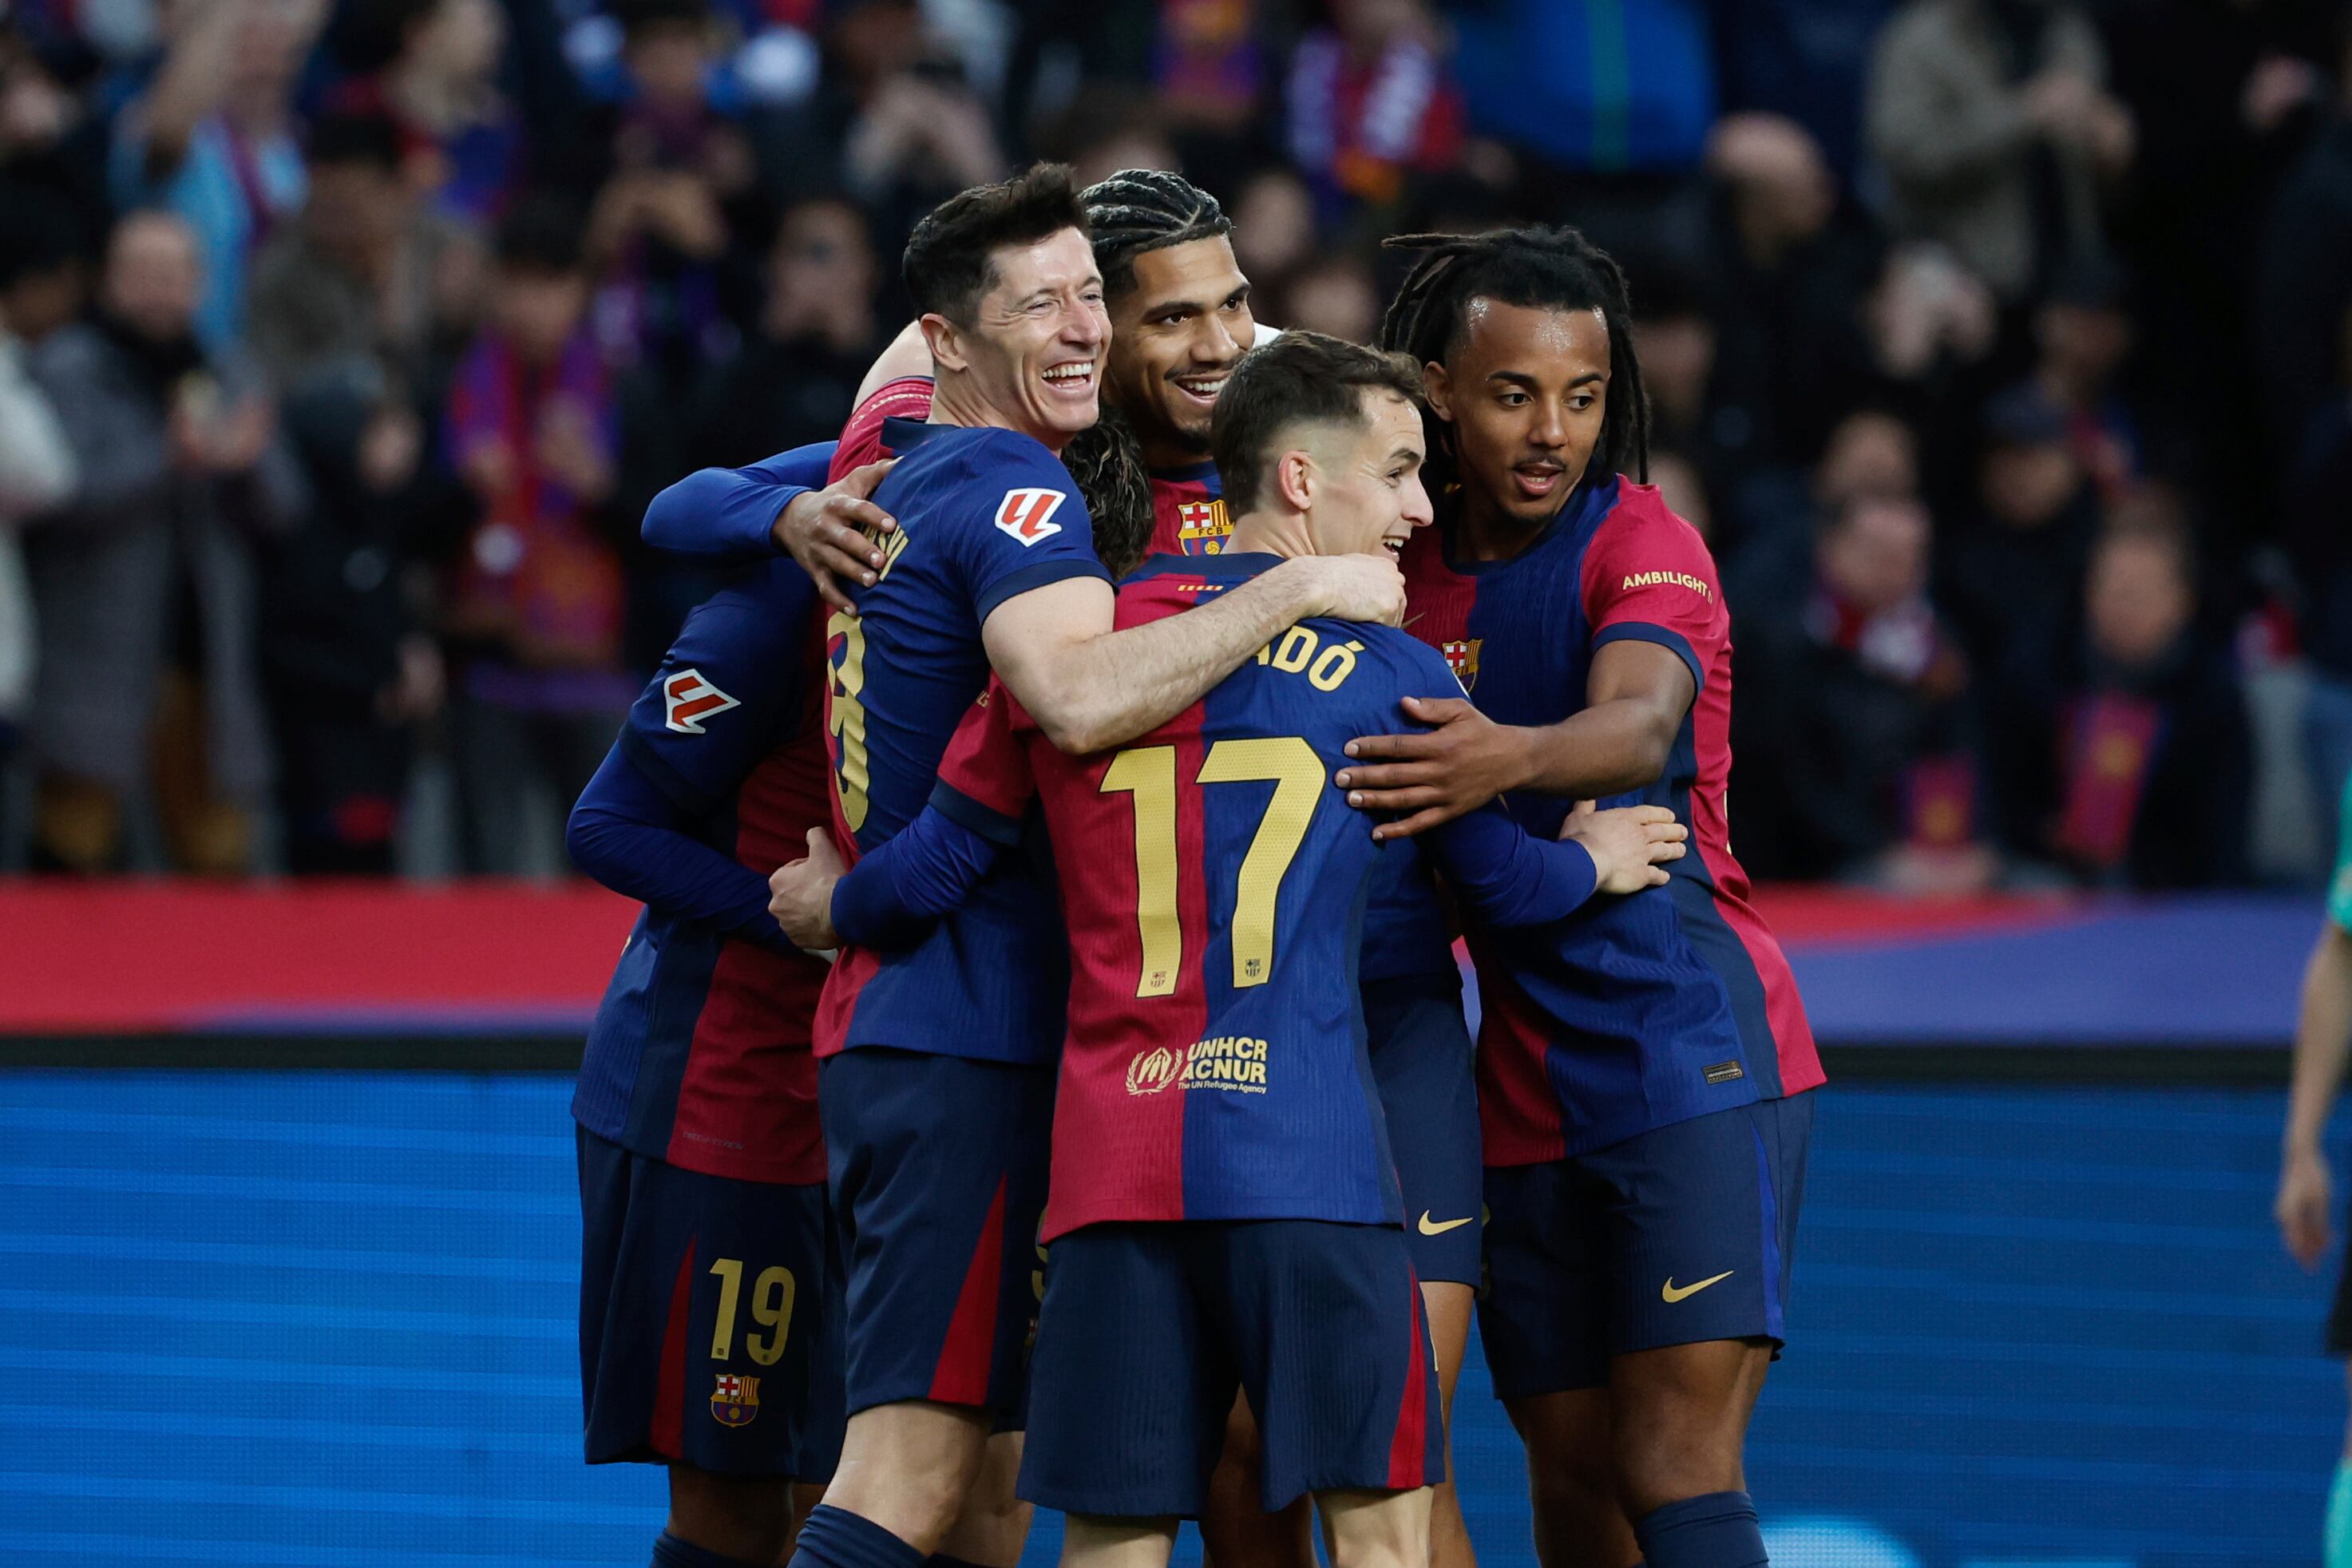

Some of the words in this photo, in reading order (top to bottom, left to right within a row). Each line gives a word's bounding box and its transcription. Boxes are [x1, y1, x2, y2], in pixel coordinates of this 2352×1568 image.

[1198, 527, 1223, 537] FCB
[1622, 571, 1708, 596] AMBILIGHT
[1099, 736, 1327, 998] 17
[1186, 1036, 1268, 1062] UNHCR
[1178, 1058, 1267, 1084] ACNUR
[1204, 1081, 1237, 1091] Refugee
[1238, 1083, 1266, 1095] Agency
[709, 1257, 795, 1366] 19
